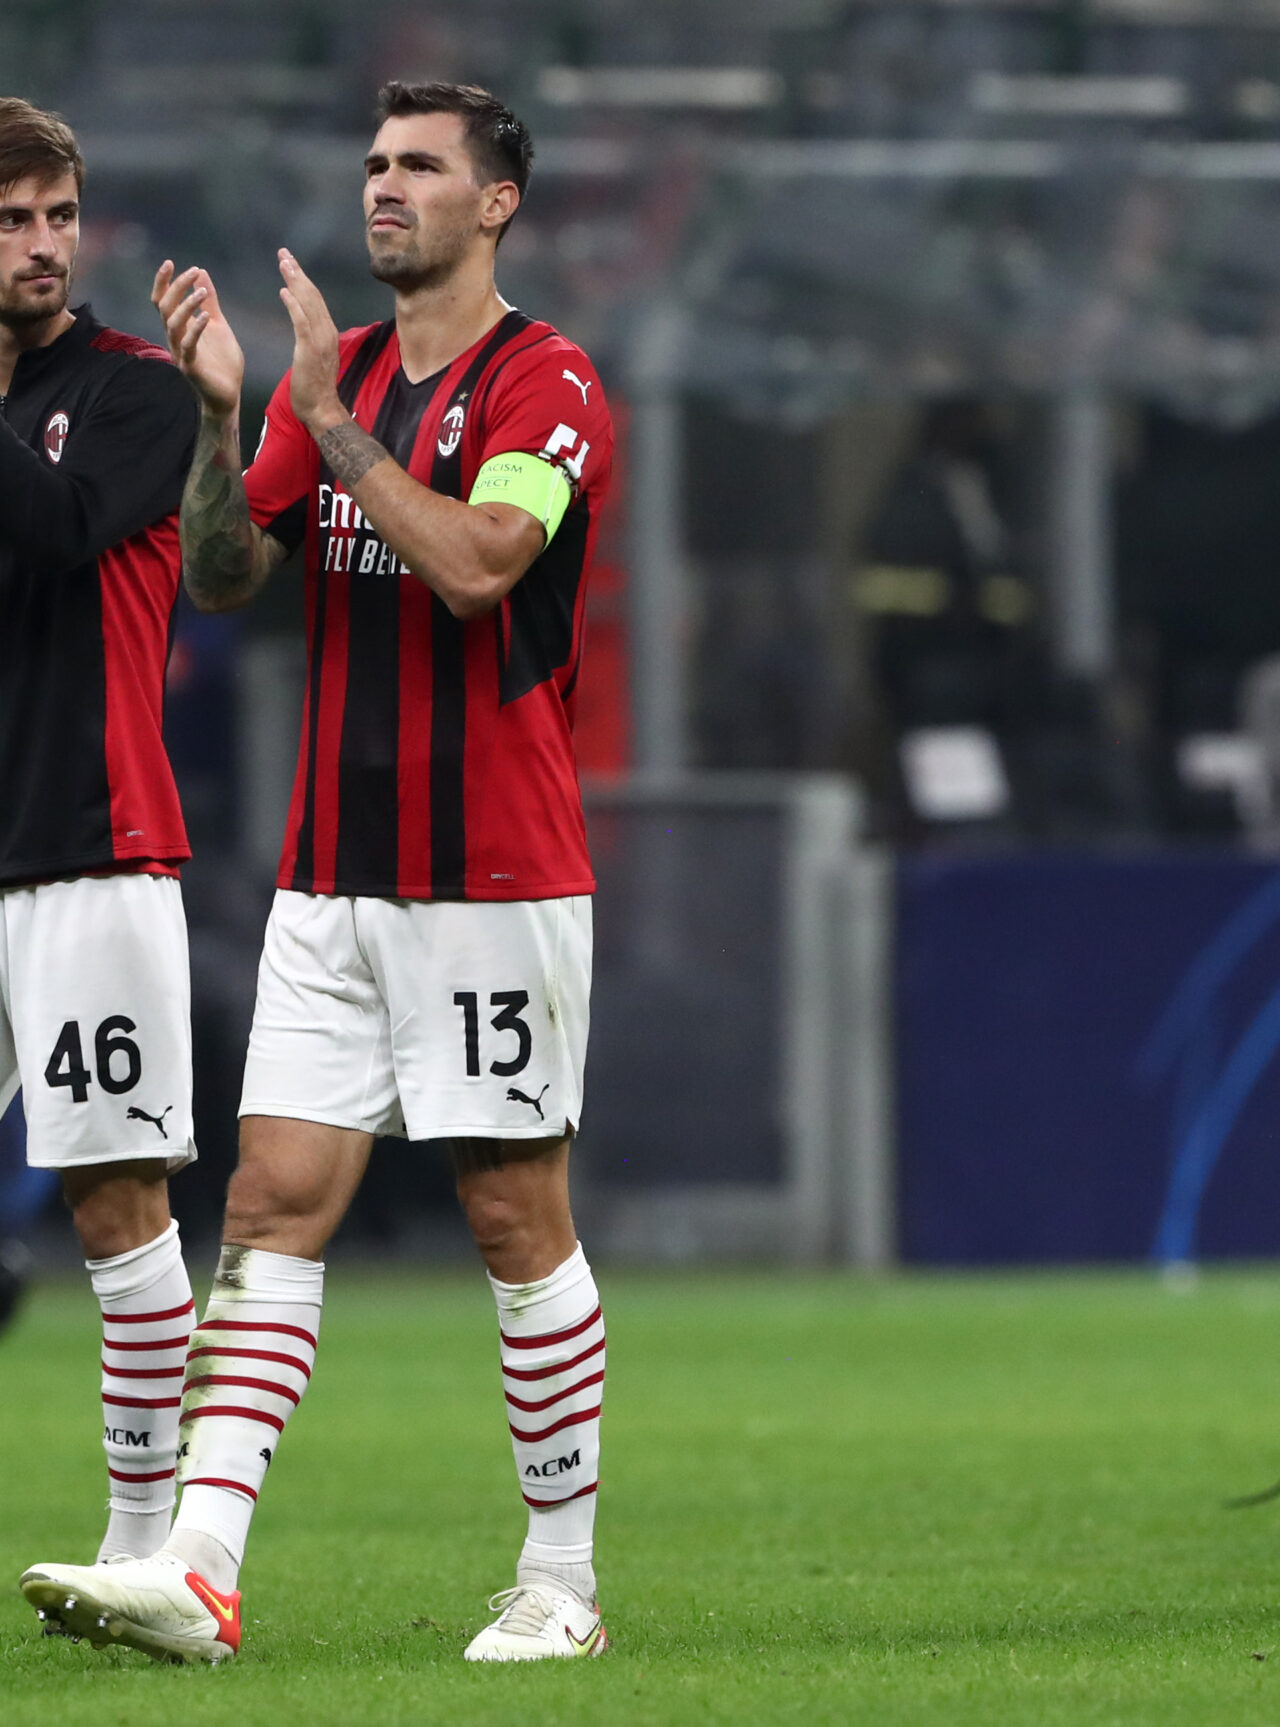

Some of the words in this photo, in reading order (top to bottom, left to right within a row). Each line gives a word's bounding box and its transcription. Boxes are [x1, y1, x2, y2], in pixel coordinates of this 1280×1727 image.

[325, 536, 356, 572] FLY
[453, 990, 532, 1077] 13
[44, 1014, 142, 1103] 46
[104, 1426, 151, 1448] ACM
[525, 1448, 581, 1477] ACM
